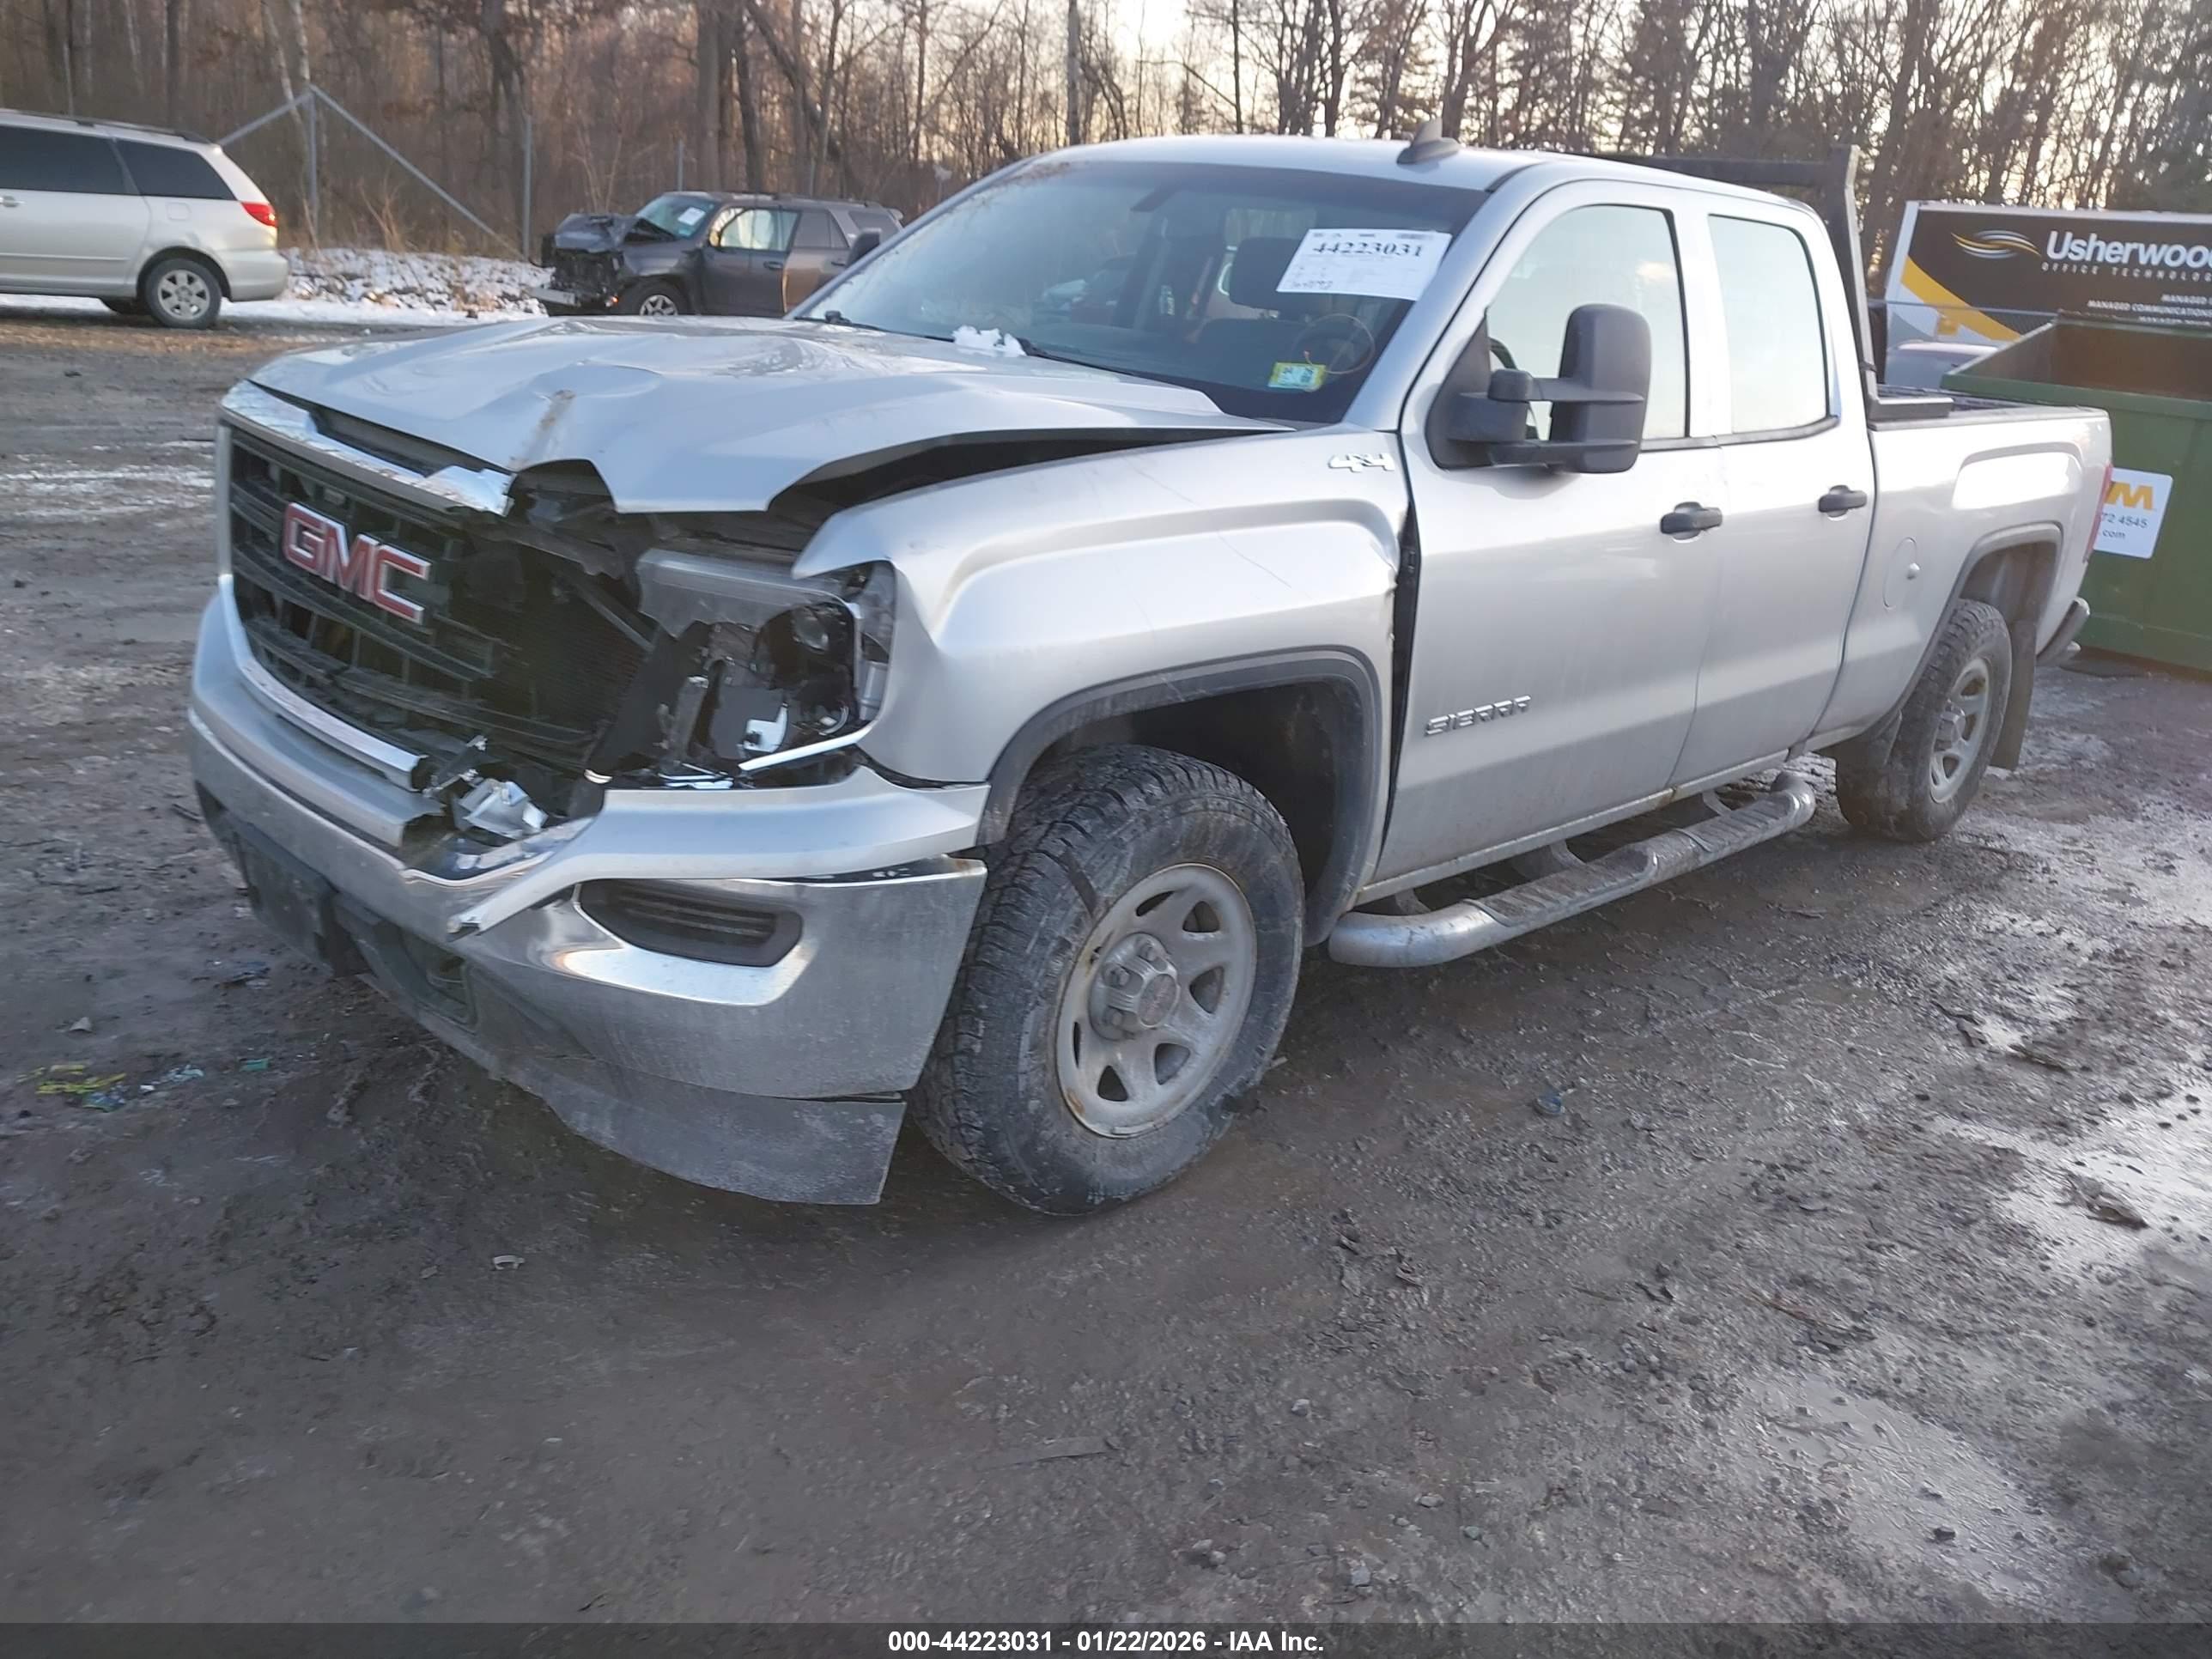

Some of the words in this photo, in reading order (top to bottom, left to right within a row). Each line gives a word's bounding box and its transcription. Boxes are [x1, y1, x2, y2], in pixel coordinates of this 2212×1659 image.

[1312, 242, 1423, 258] 44223031
[2041, 261, 2100, 276] OFFICE
[2046, 230, 2212, 269] Usherwoo
[283, 501, 433, 625] GMC
[1424, 694, 1532, 737] SIERRA
